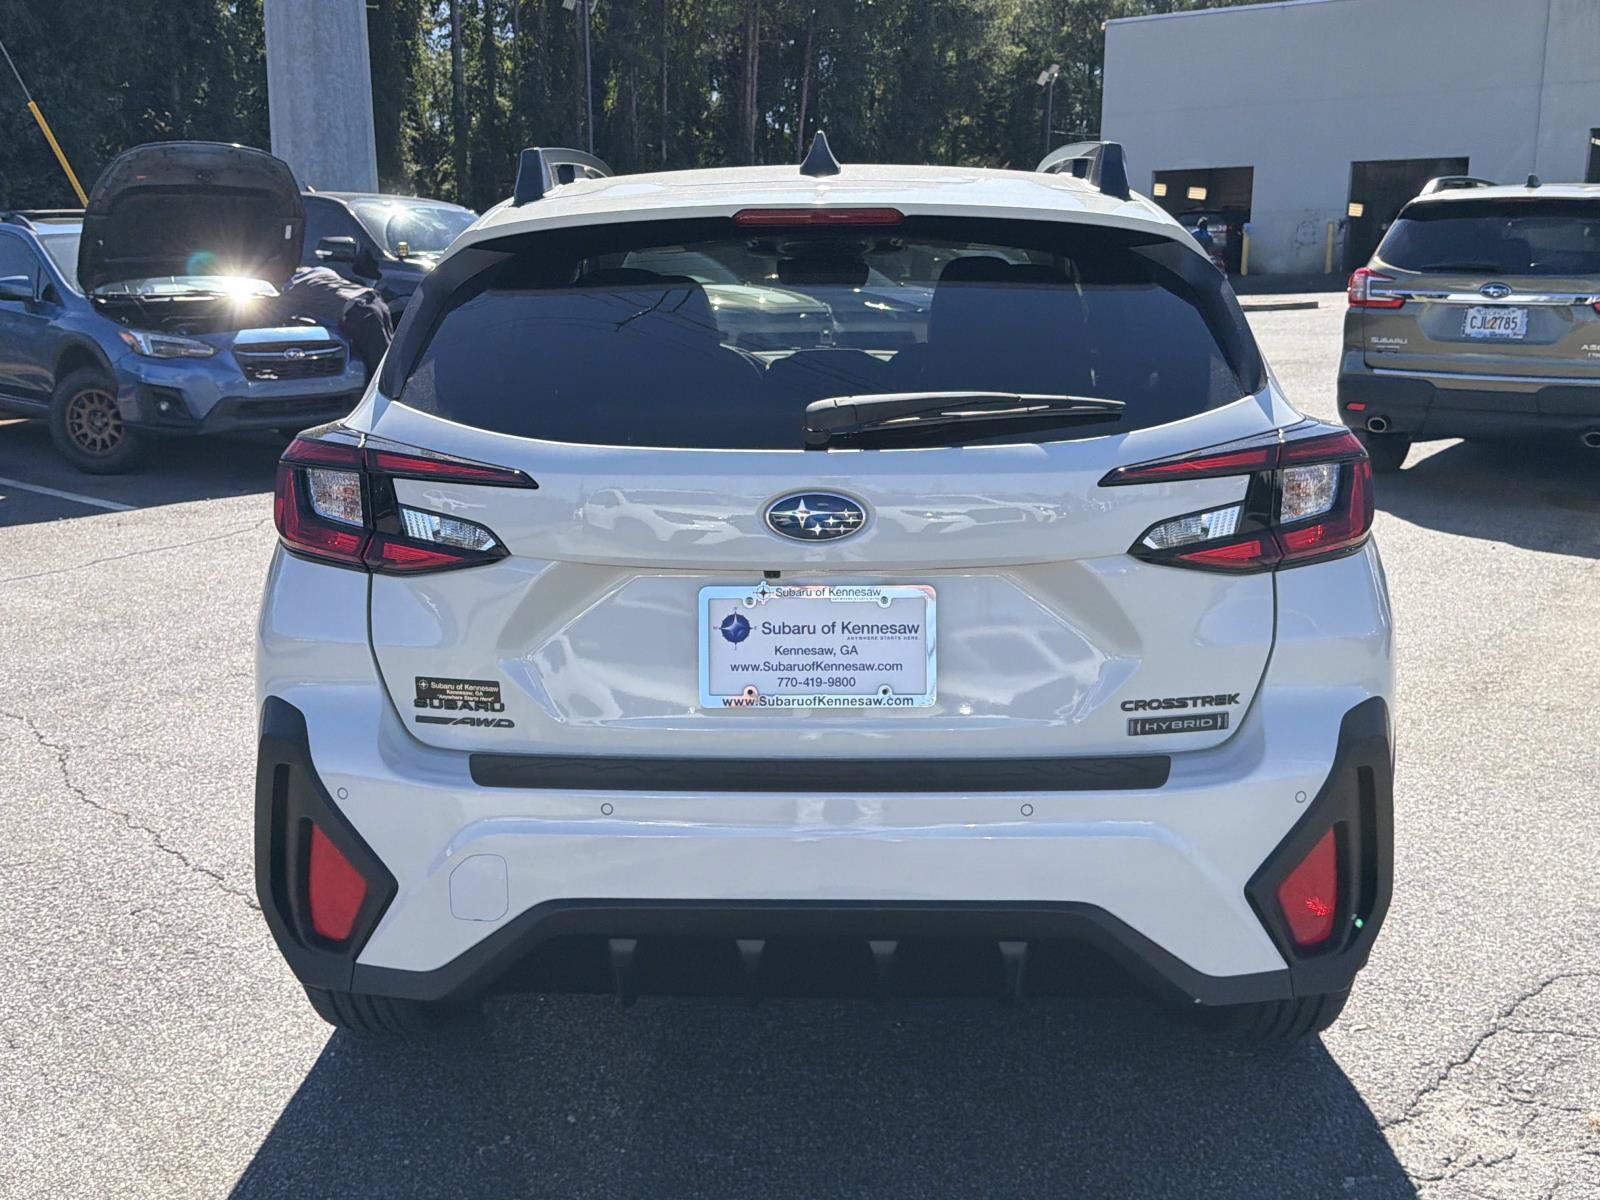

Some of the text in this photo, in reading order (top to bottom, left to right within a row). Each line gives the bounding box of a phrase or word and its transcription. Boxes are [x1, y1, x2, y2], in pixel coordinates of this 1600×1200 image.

[1470, 315, 1518, 330] CJL2785
[775, 587, 881, 597] Subaru of Kennesaw
[761, 621, 920, 636] Subaru of Kennesaw
[774, 645, 859, 657] Kennesaw, GA
[730, 661, 903, 672] www.SubaruofKennesaw.com
[430, 682, 455, 690] Subaru
[464, 684, 499, 692] Kennesaw
[777, 677, 857, 688] 770-419-9800
[414, 698, 505, 712] SUBARU
[722, 696, 914, 707] www.SubaruofKennesaw.com
[1120, 693, 1240, 712] CROSSTREK
[452, 717, 515, 728] AWD
[1145, 718, 1213, 731] HYBRID
